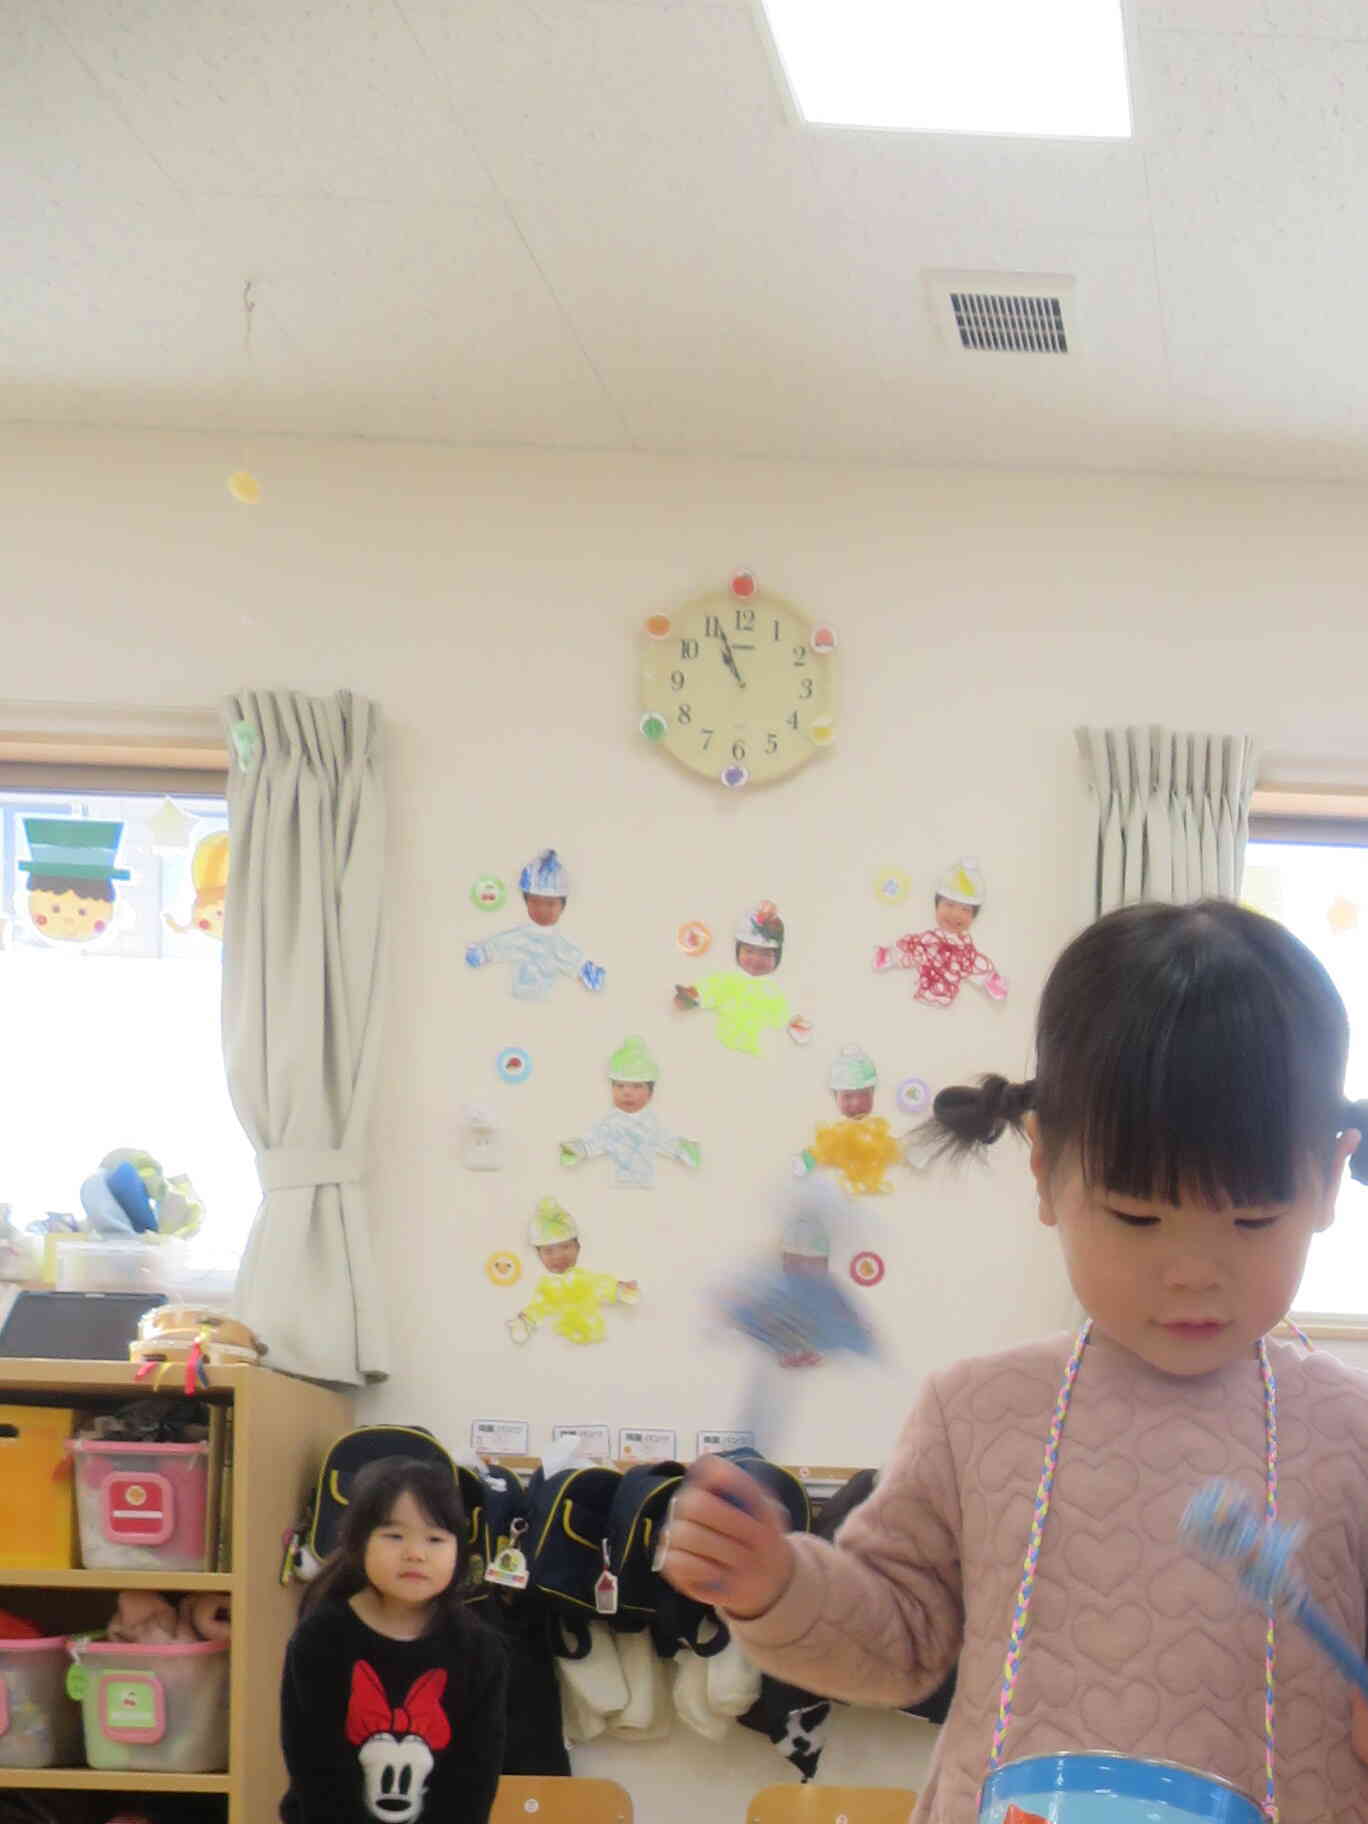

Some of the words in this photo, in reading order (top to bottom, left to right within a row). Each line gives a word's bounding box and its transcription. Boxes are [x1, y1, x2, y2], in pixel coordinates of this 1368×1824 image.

[705, 616, 720, 638] 11
[735, 610, 755, 632] 12
[773, 620, 780, 642] 1
[681, 638, 699, 660] 10
[793, 646, 806, 667] 2
[671, 670, 685, 692] 9
[800, 678, 813, 700] 3
[678, 704, 691, 725] 8
[786, 710, 799, 730] 4
[701, 729, 714, 750] 7
[732, 740, 745, 761] 6
[765, 733, 778, 755] 5
